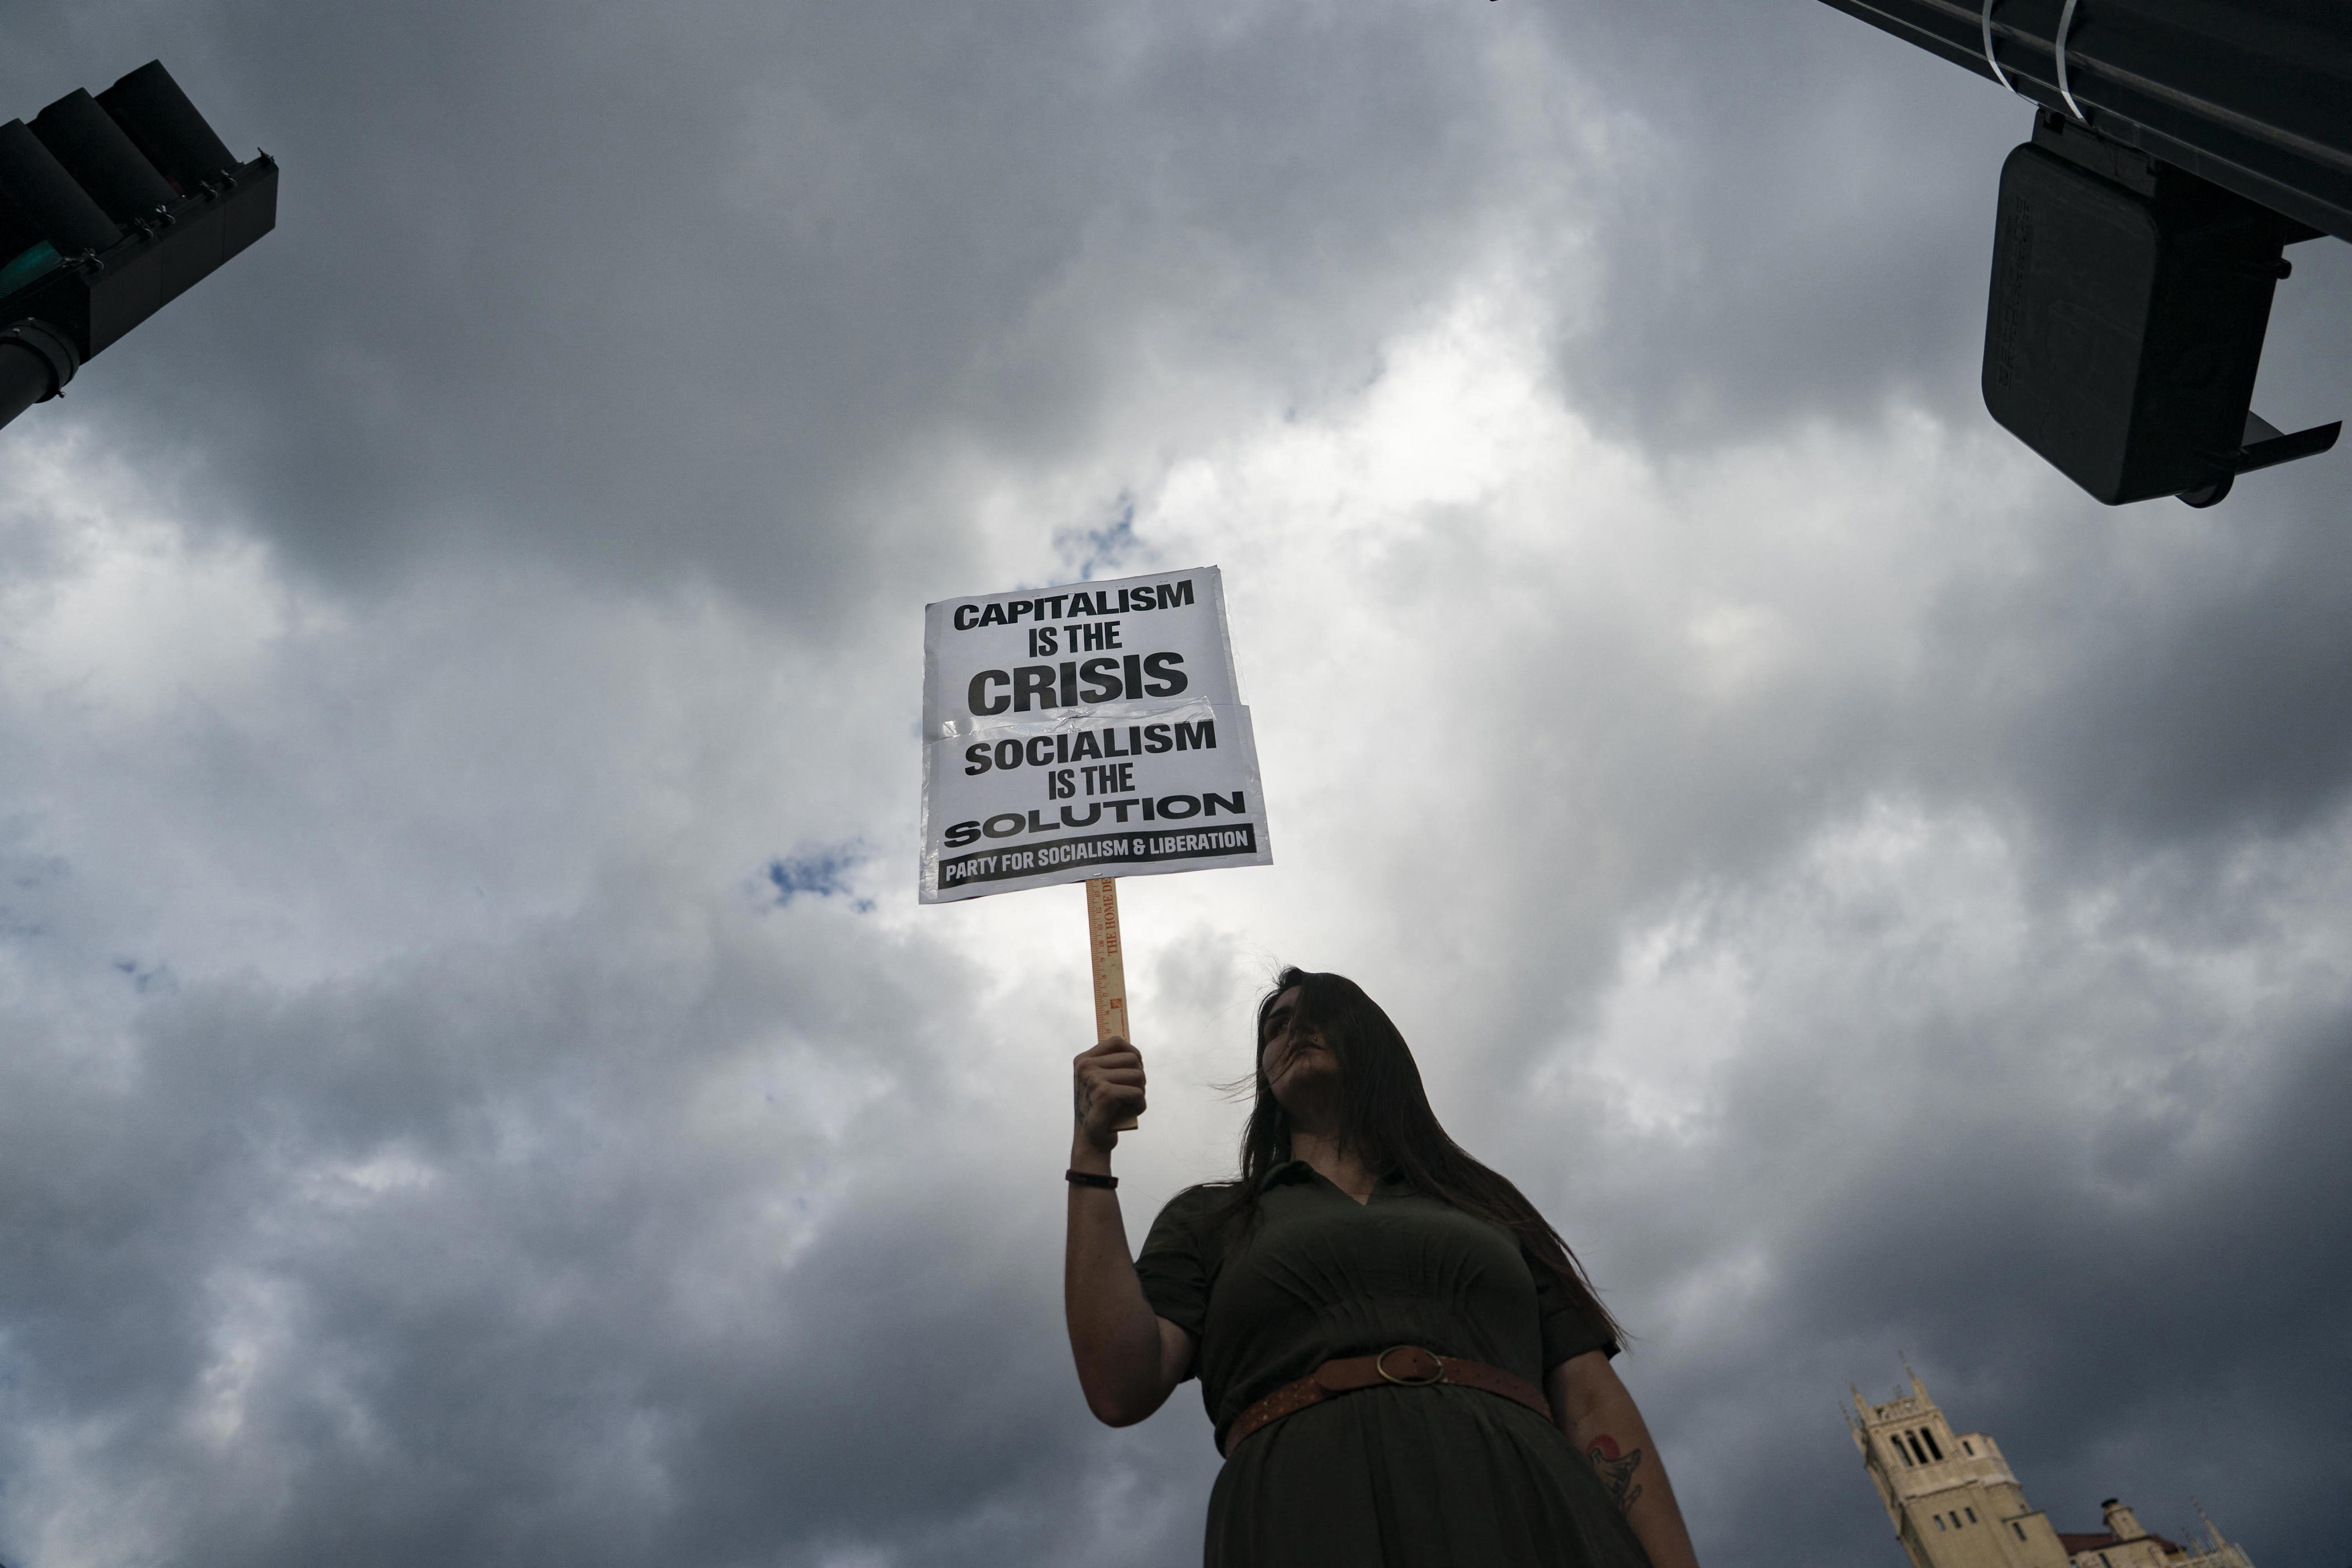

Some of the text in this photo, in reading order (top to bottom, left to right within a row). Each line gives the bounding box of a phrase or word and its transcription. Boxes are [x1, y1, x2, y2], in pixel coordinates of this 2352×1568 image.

[954, 580, 1194, 631] CAPITALISM
[1029, 621, 1122, 658] IS THE
[968, 652, 1188, 716] CRISIS
[965, 719, 1217, 776] SOCIALISM
[1049, 763, 1136, 800] IS THE
[944, 791, 1246, 848] SOLUTION
[946, 830, 1249, 882] PARTY FOR SOCIALISM & LIBERATION
[1103, 895, 1115, 929] HOME
[1107, 932, 1117, 956] THE
